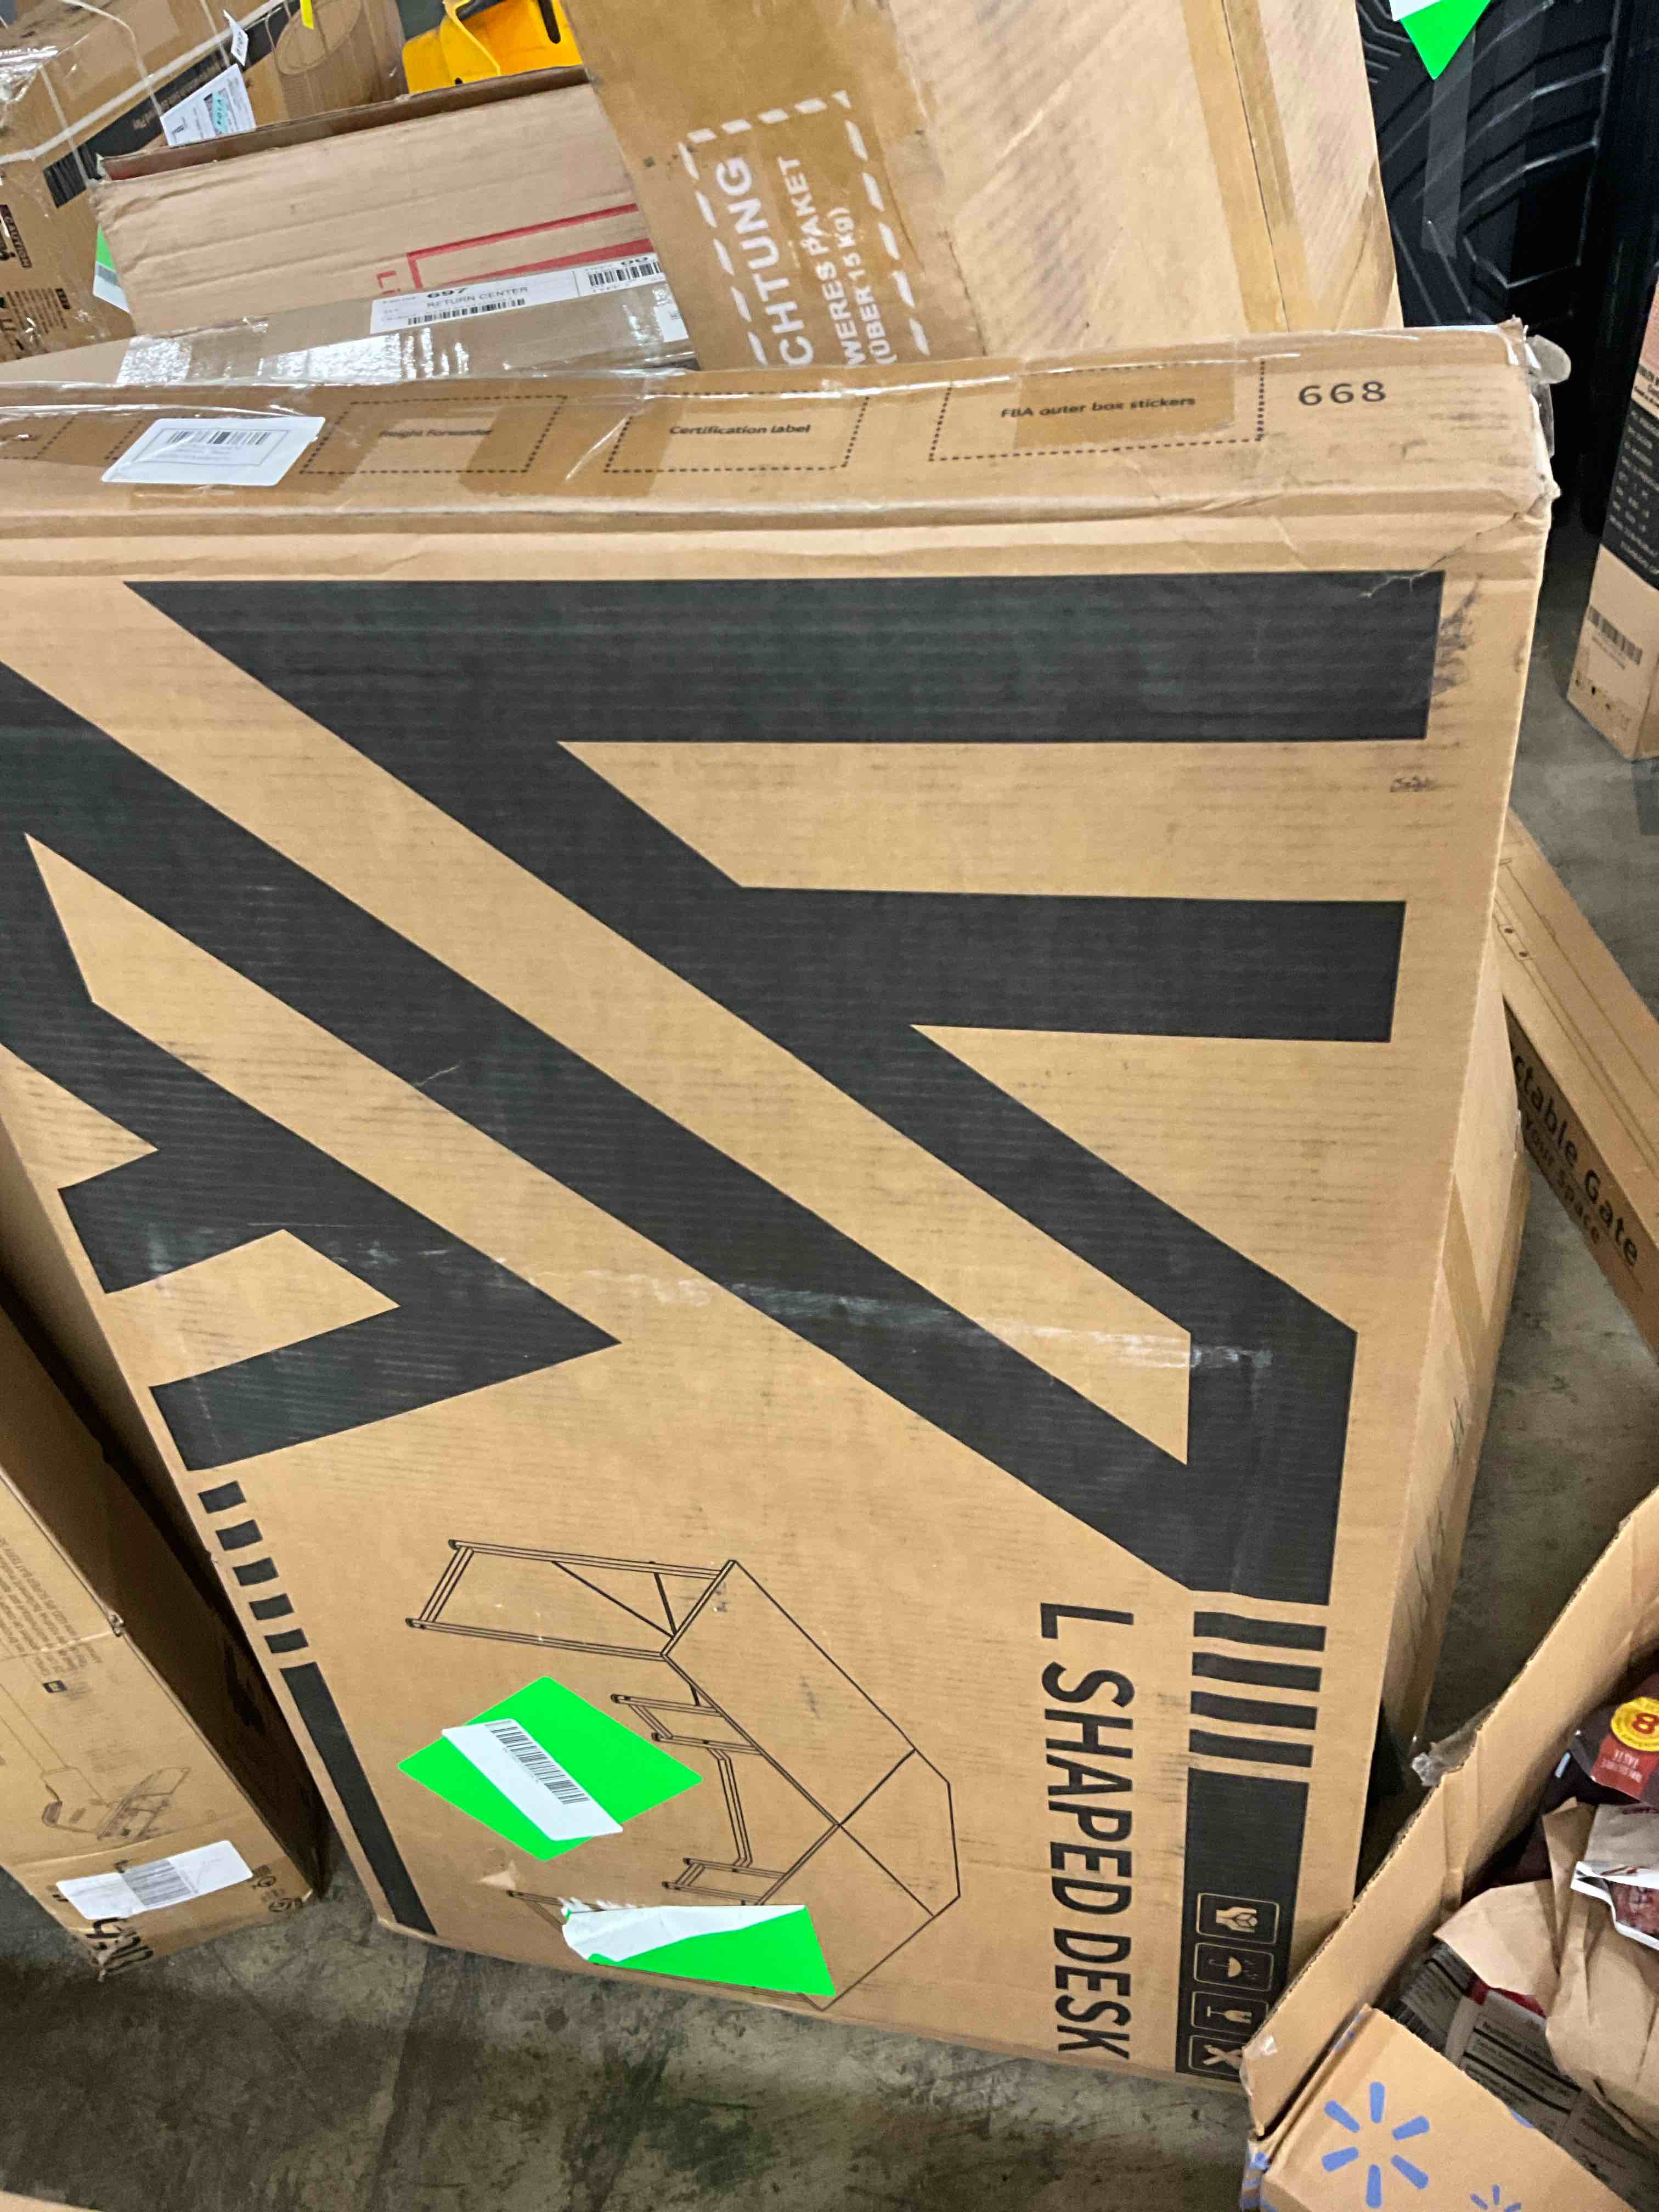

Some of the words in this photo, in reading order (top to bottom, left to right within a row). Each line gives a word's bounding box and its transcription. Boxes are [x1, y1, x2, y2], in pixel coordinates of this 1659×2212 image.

[777, 156, 830, 256] PAKET
[843, 252, 866, 281] 15
[427, 296, 475, 308] RETURN
[479, 286, 528, 300] CENTER
[1000, 408, 1034, 417] FBA
[1039, 404, 1087, 416] outer
[1091, 402, 1124, 411] box
[1130, 397, 1196, 410] stickers
[1298, 381, 1386, 406] 668
[669, 425, 767, 434] Certification
[1510, 1042, 1578, 1169] ctable
[1584, 1170, 1638, 1266] Gate
[1040, 1602, 1134, 1639] L
[1041, 1661, 1135, 1915] SHAPED
[1053, 1927, 1132, 2060] DESK
